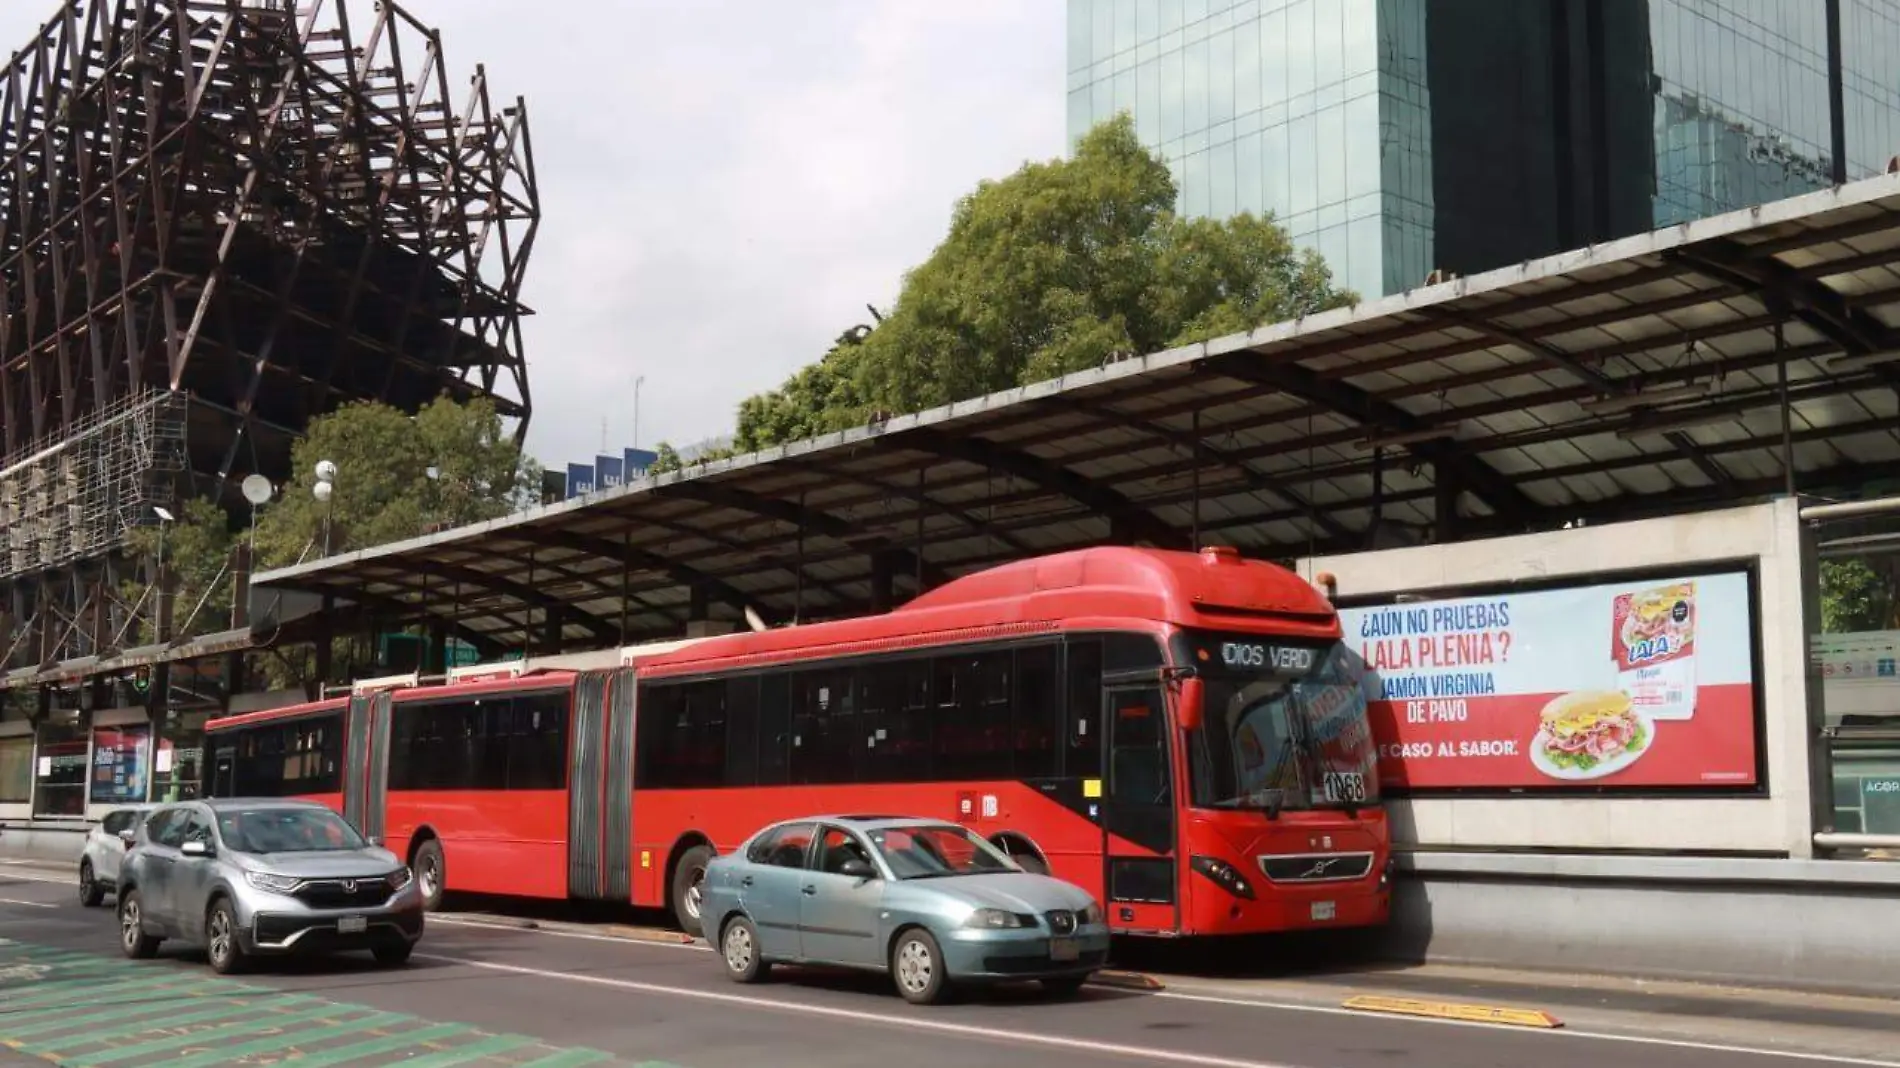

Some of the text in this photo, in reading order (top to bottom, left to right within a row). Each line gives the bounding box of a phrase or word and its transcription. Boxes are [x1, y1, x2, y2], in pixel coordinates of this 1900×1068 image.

[1361, 601, 1510, 638] ¿AÚN NO PRUEBAS
[1362, 640, 1412, 671] LALA
[1431, 672, 1495, 696] VIRGINIA
[1407, 700, 1468, 723] DE PAVO
[1390, 743, 1432, 758] CASO
[1437, 742, 1456, 757] AL
[1325, 774, 1364, 800] 1068
